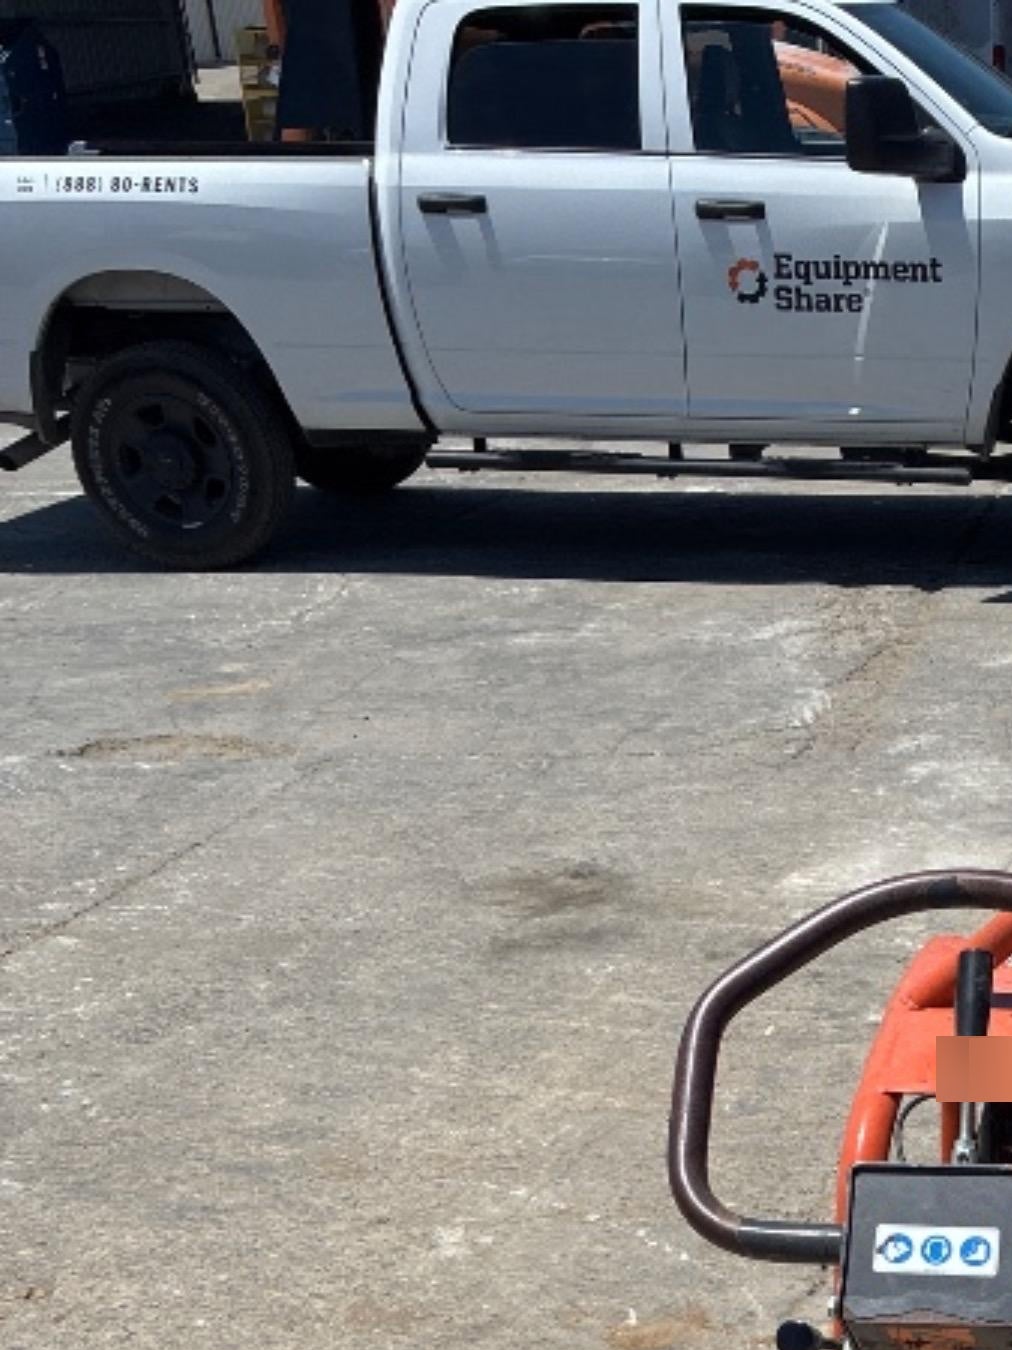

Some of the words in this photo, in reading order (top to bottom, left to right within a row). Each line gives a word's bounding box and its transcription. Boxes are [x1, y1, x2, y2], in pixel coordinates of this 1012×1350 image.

[110, 176, 200, 194] 80-RENTS
[773, 252, 943, 286] Equipment
[773, 285, 865, 313] Share
